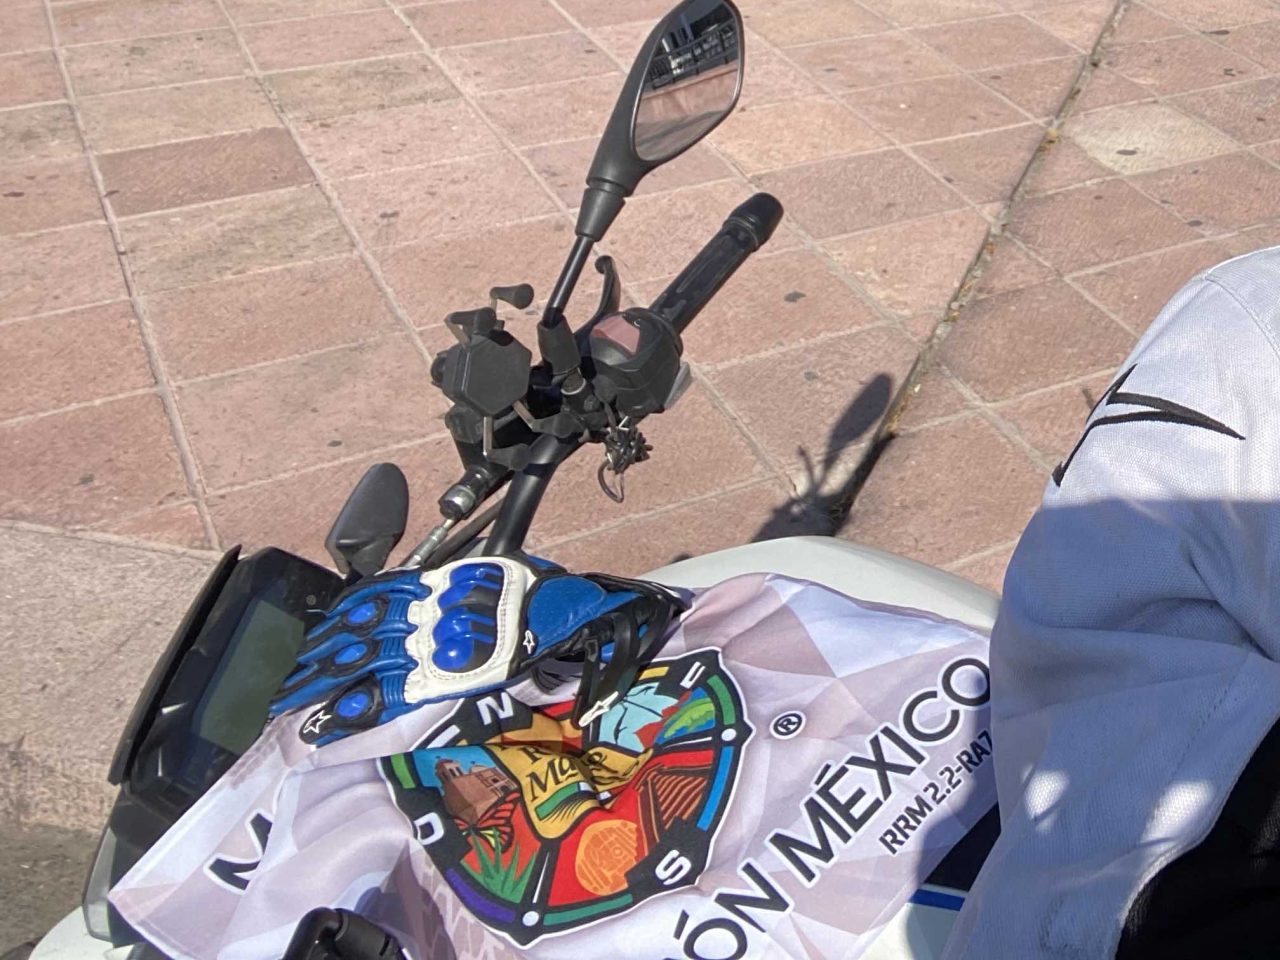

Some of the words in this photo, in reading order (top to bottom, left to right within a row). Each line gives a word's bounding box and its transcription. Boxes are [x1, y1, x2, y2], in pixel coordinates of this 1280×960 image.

[476, 692, 514, 725] N
[766, 657, 990, 883] MÉXICO
[878, 794, 934, 855] RRM
[655, 849, 692, 886] S
